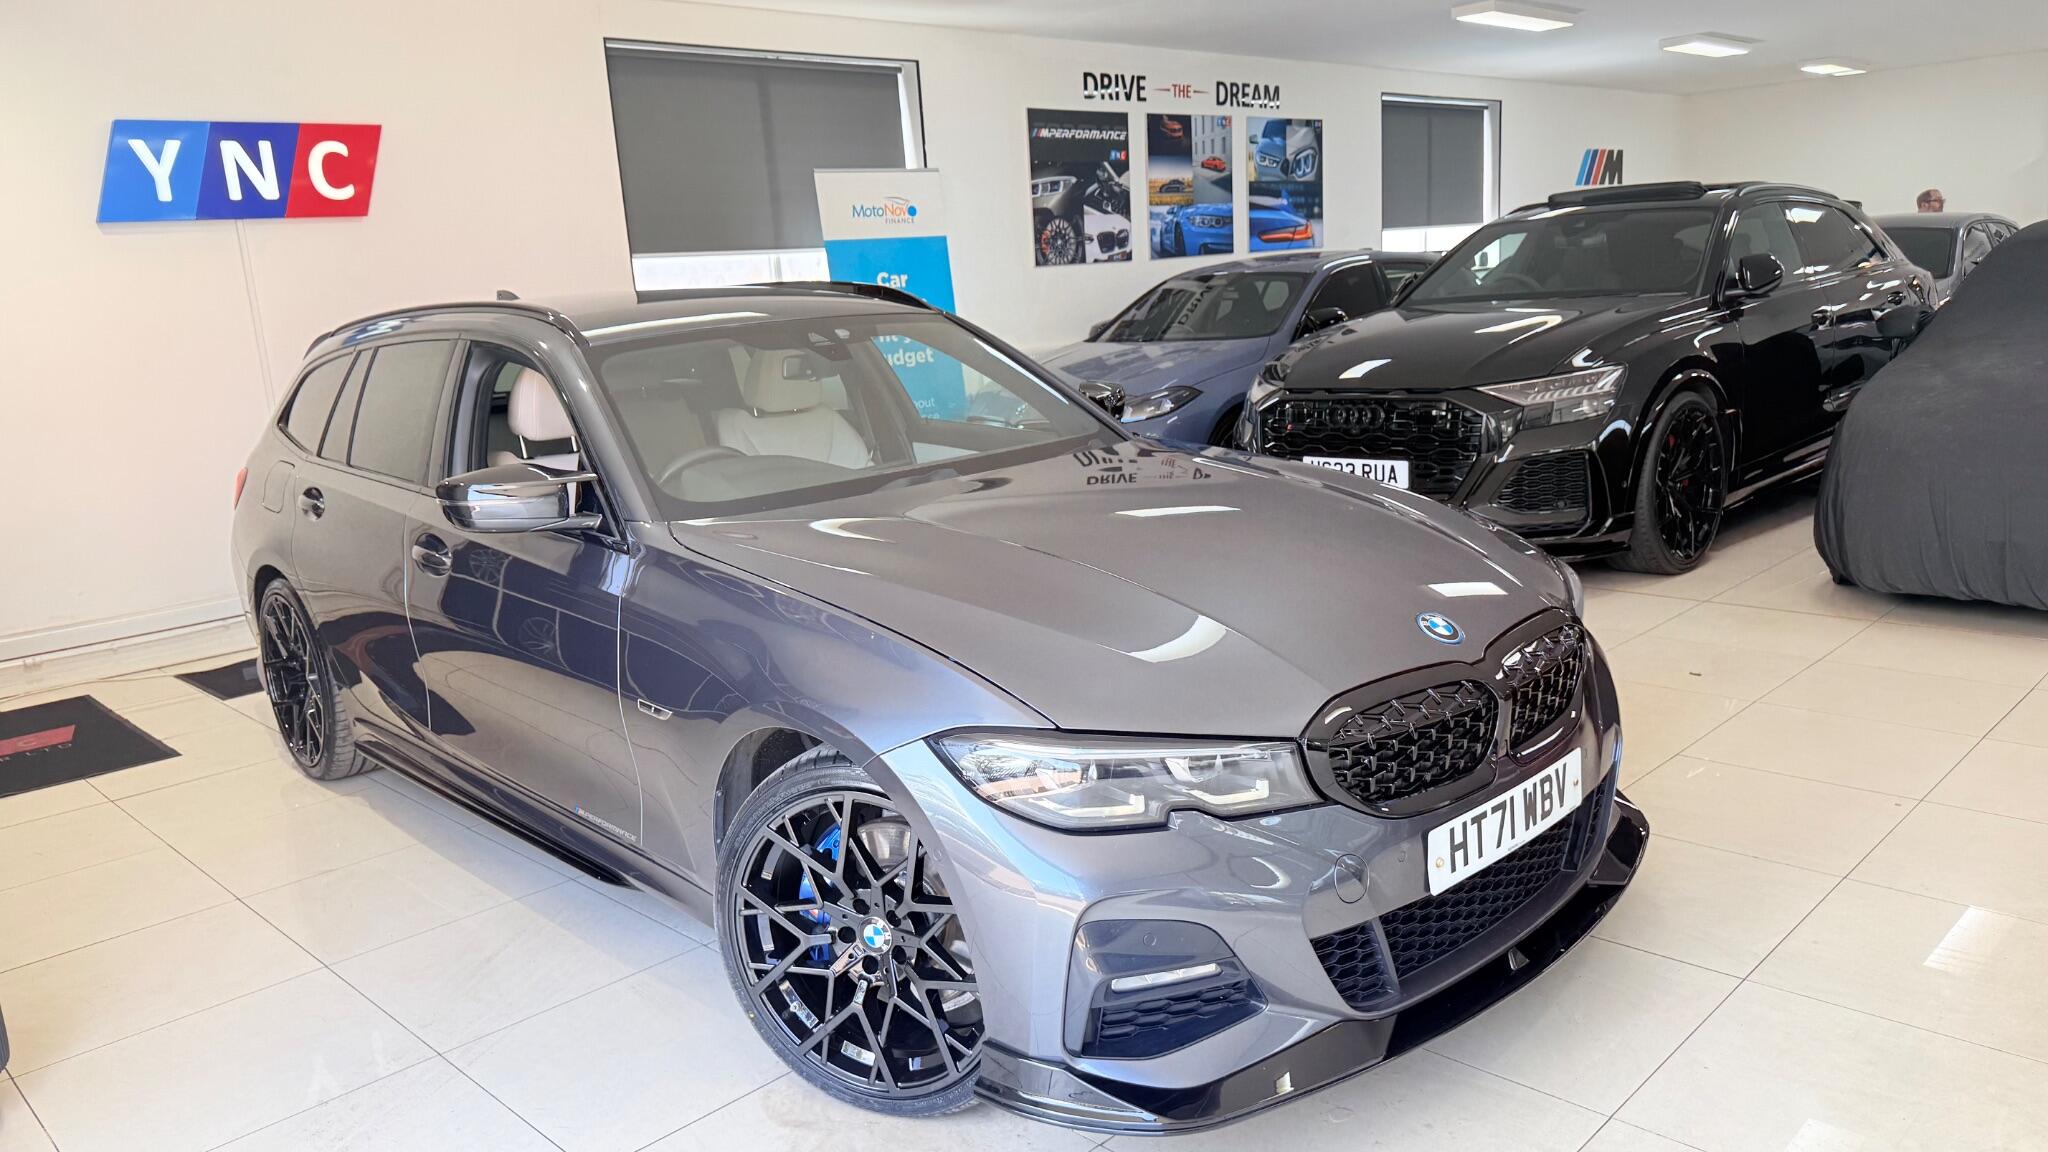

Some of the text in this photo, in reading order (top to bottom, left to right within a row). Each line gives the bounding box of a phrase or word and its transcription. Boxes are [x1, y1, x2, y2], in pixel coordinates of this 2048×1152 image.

[1083, 71, 1280, 110] DRIVE THE DREAM
[127, 138, 355, 202] YNC
[884, 217, 915, 225] FINANCE
[876, 271, 908, 288] Car
[1361, 463, 1398, 484] RUA
[1449, 762, 1567, 874] HT71 WBV
